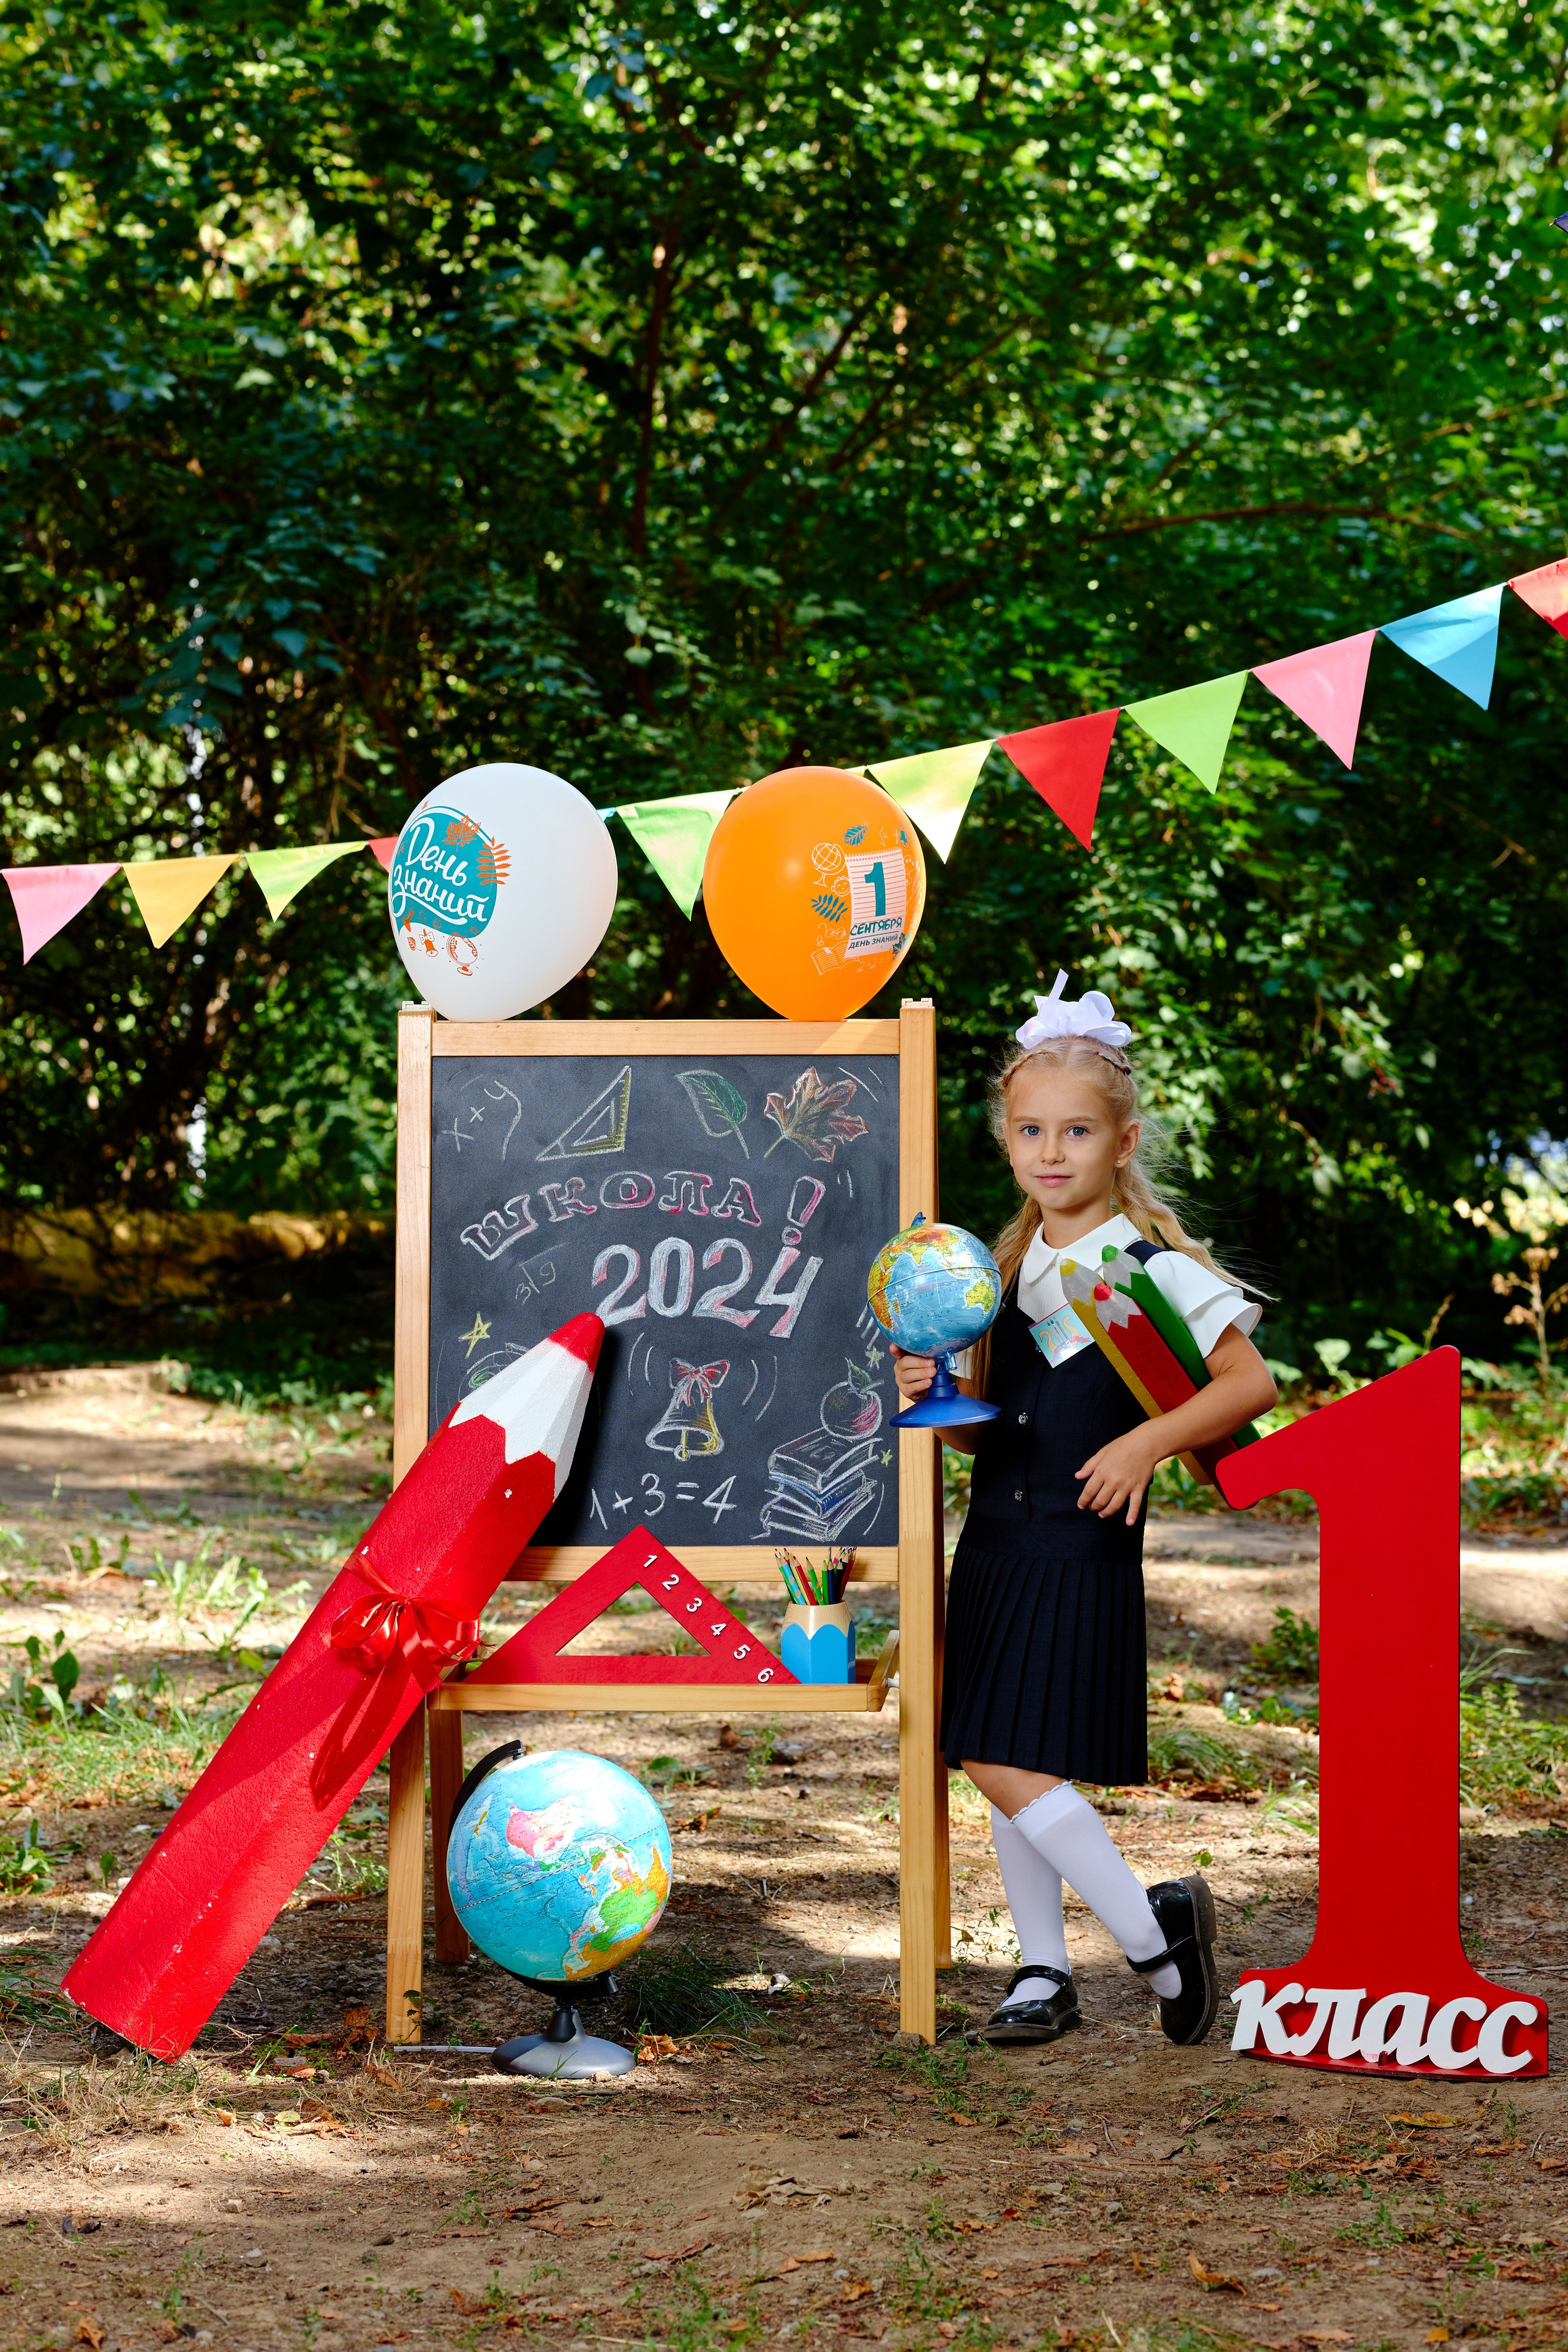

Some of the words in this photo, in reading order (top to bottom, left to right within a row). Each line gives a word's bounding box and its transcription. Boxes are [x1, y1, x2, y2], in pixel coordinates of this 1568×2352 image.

[405, 817, 468, 886] День
[864, 861, 886, 917] 1
[848, 940, 870, 950] ДЕНЬ
[872, 933, 899, 944] ЗНАНИЙ
[850, 917, 902, 935] СЕНТЯБРЯ
[591, 1237, 823, 1339] 2024
[643, 1555, 658, 1568] 1
[662, 1574, 680, 1591] 2
[686, 1597, 703, 1612] 3
[710, 1623, 727, 1637] 4
[734, 1644, 751, 1660] 5
[758, 1668, 774, 1683] 6
[1216, 1344, 1548, 2081] 1
[1230, 1980, 1538, 2074] класс
